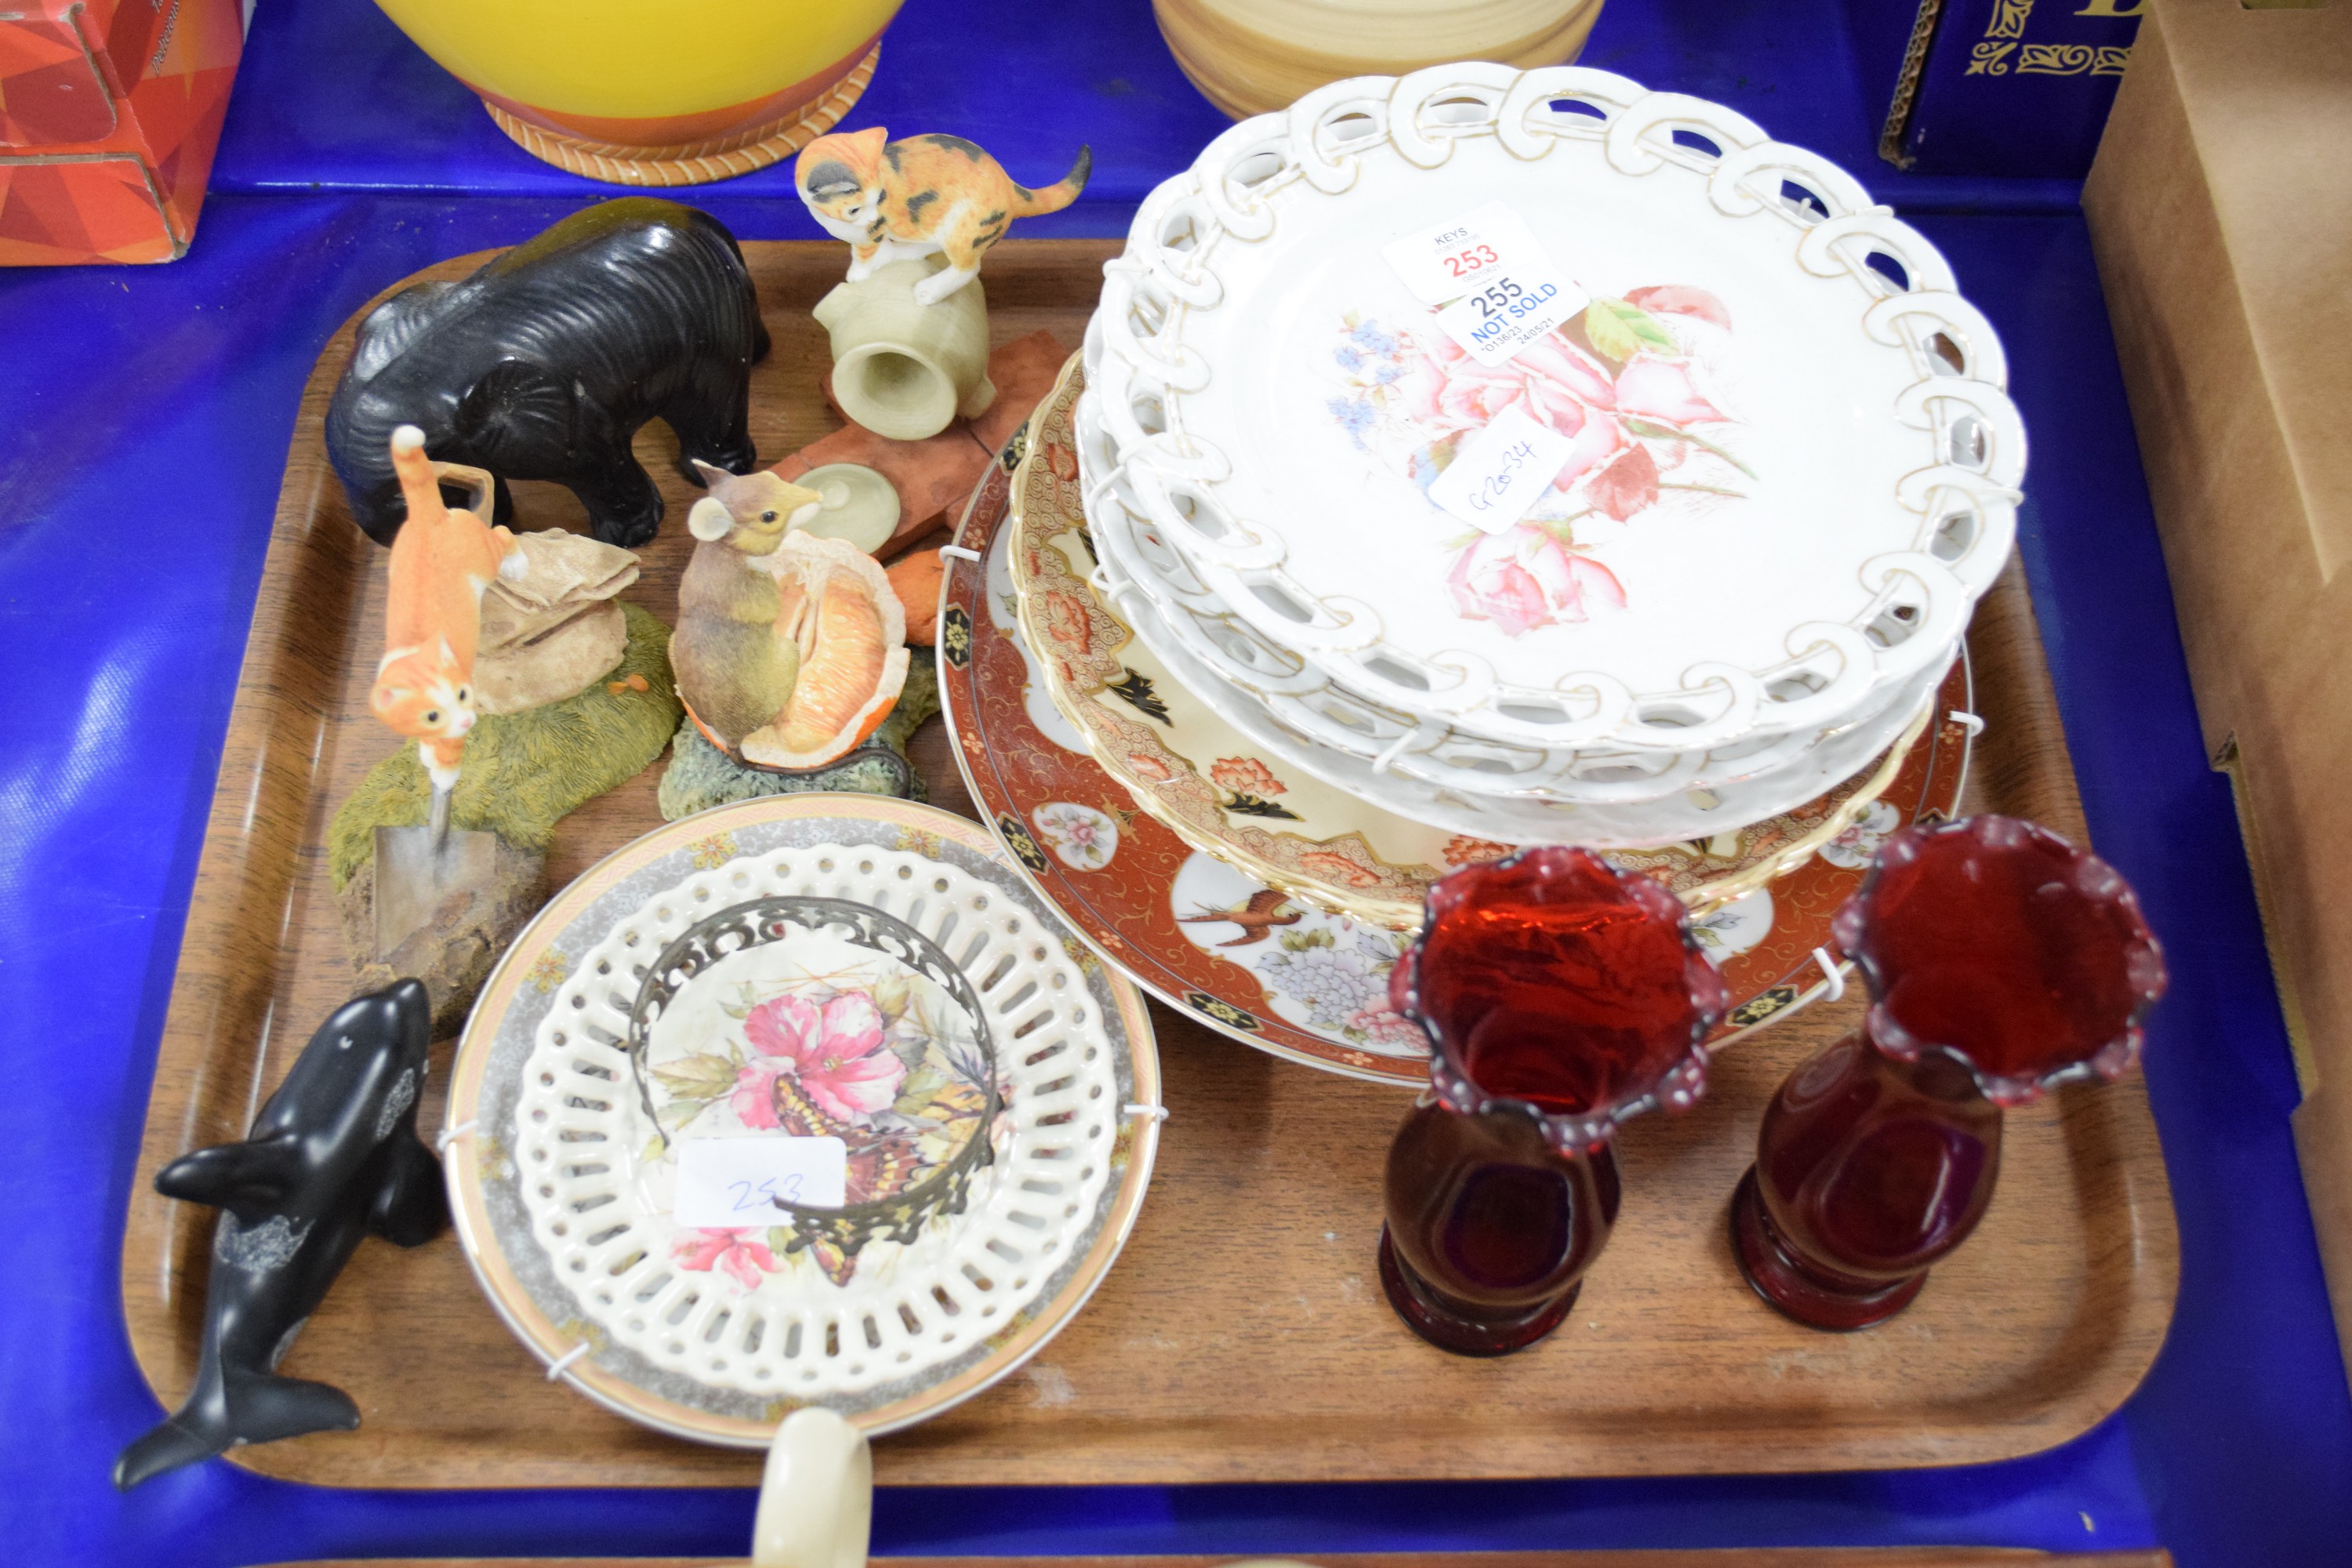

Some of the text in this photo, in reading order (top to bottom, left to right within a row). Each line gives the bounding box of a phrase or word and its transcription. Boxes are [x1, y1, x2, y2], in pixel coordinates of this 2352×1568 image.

[1435, 227, 1468, 245] KEYS
[1443, 245, 1499, 278] 253
[1471, 278, 1523, 318] 255
[1471, 283, 1558, 343] NOT SOLD
[1516, 318, 1555, 345] 24/05/21
[728, 1173, 804, 1211] 253
